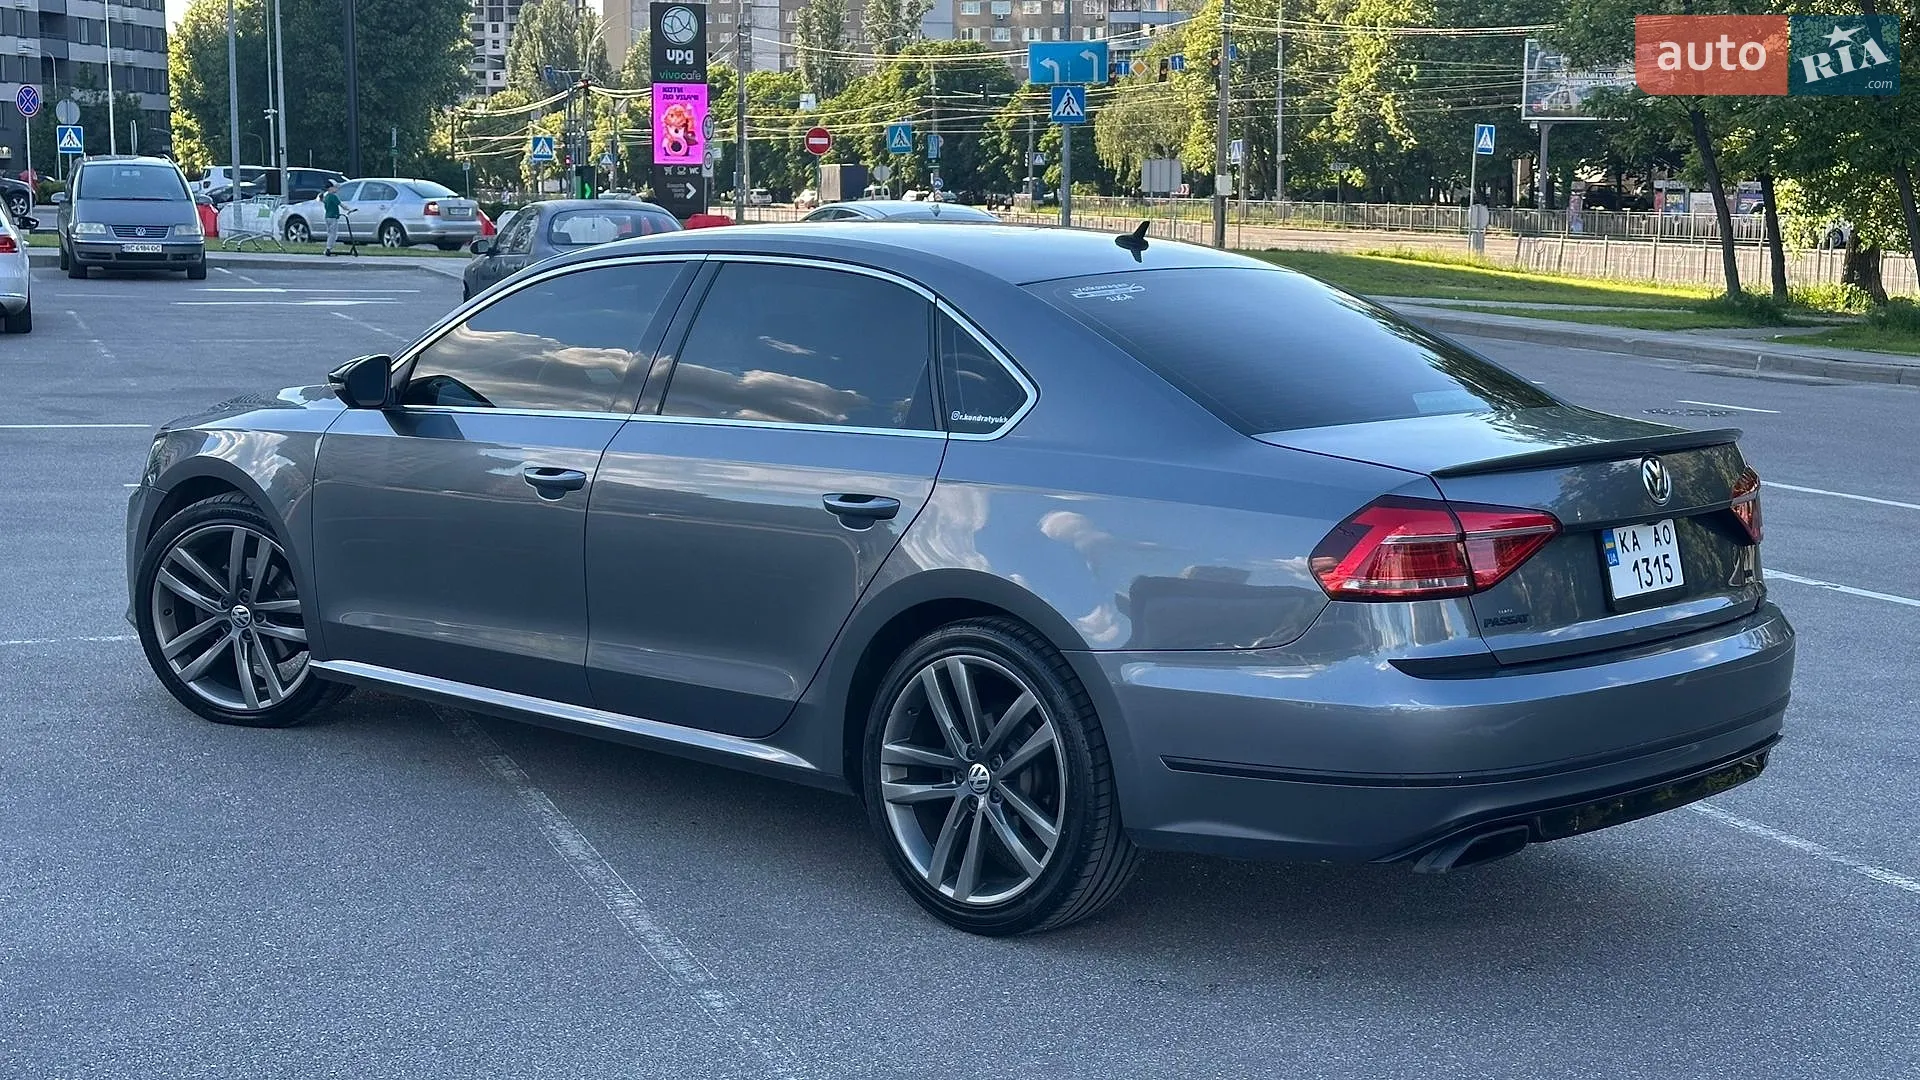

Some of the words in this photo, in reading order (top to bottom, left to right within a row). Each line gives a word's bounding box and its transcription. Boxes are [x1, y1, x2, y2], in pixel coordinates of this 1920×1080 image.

[666, 49, 694, 65] upg
[689, 167, 699, 175] WC
[1618, 530, 1641, 553] KA
[1653, 524, 1671, 547] AO
[1607, 553, 1618, 565] UA
[1632, 553, 1673, 589] 1315
[1484, 614, 1529, 628] PASSAT
